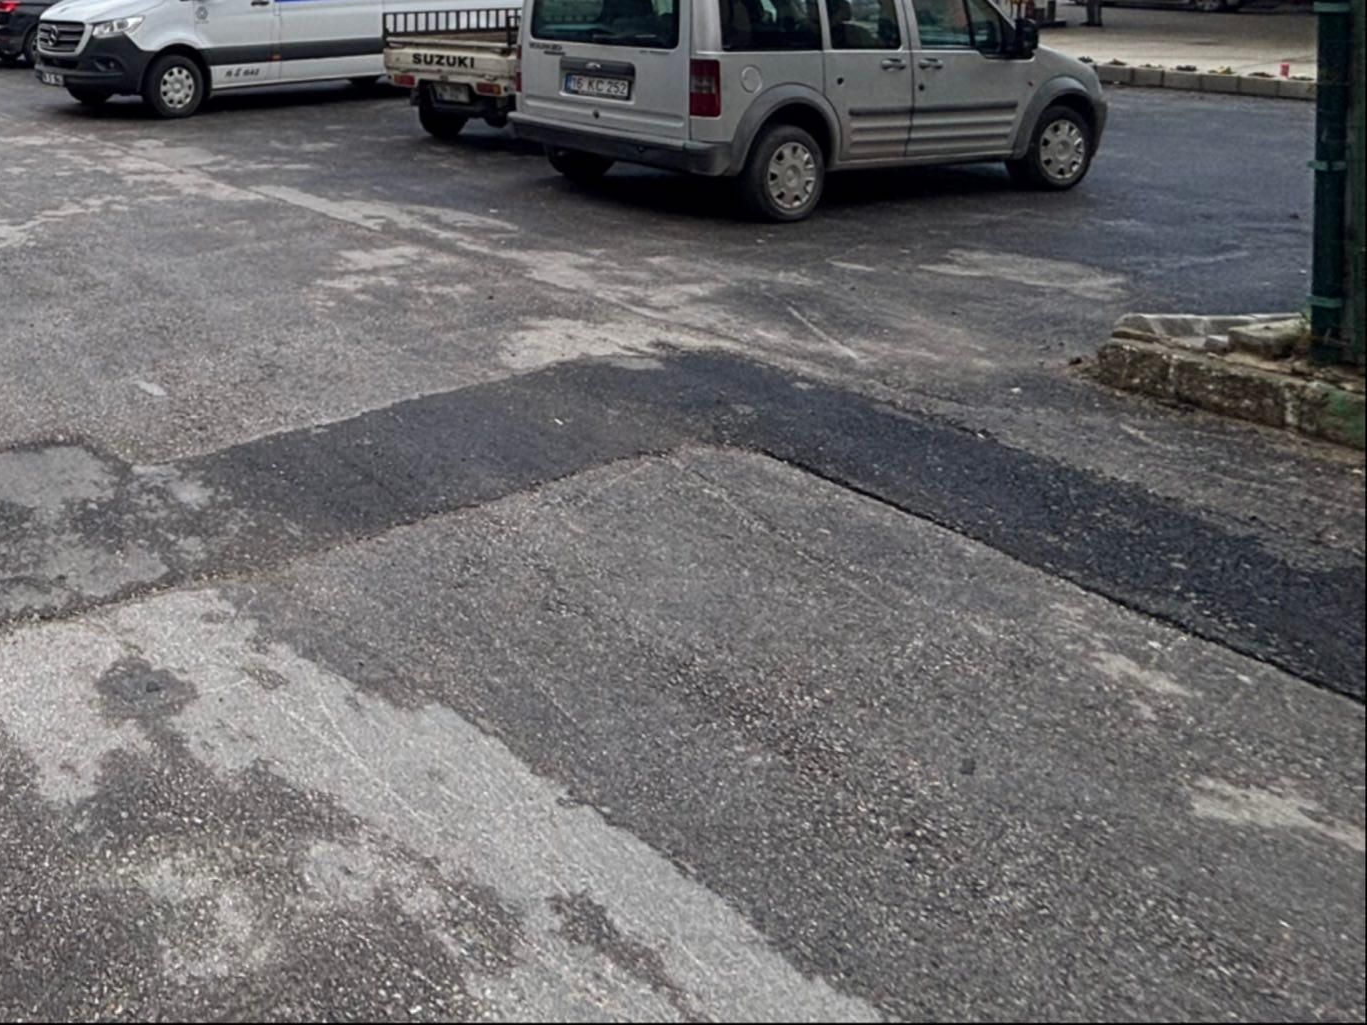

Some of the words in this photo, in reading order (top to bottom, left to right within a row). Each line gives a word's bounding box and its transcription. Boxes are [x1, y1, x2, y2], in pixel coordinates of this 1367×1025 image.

[412, 53, 476, 69] SUZUKI
[572, 77, 584, 89] 16
[587, 79, 604, 92] KC
[606, 81, 627, 95] 252
